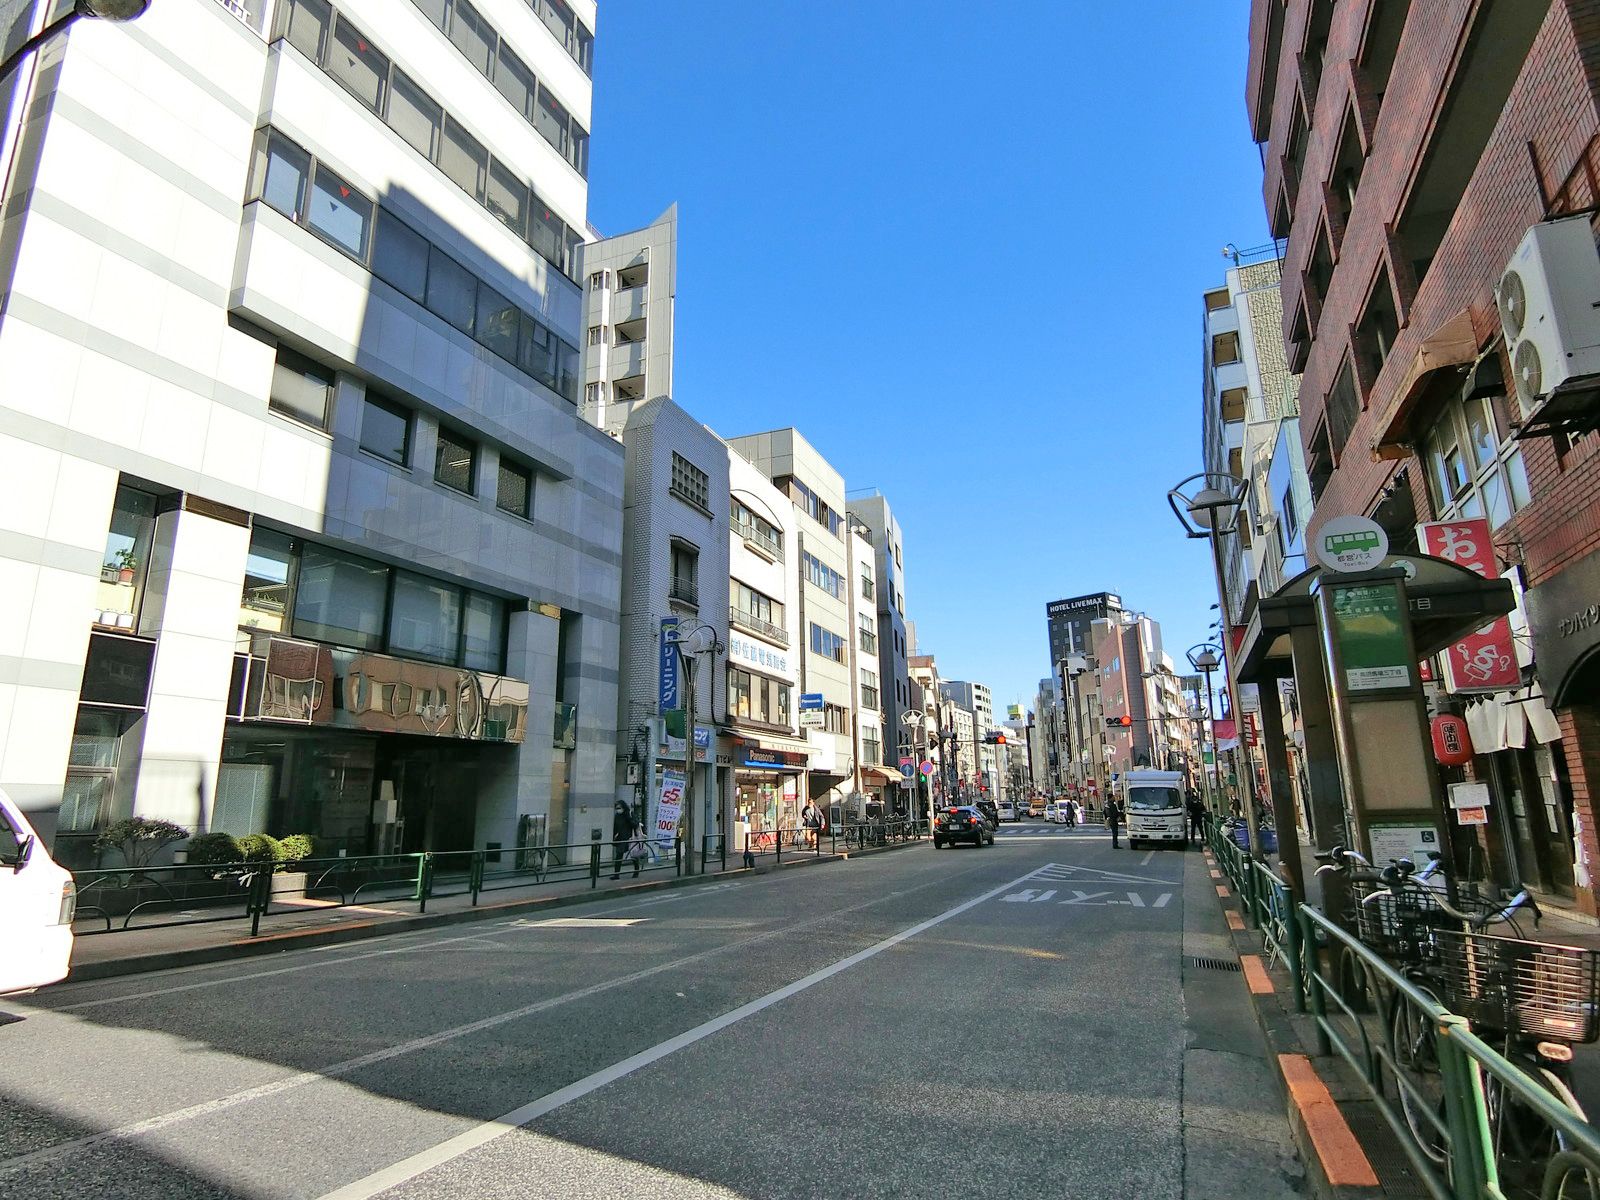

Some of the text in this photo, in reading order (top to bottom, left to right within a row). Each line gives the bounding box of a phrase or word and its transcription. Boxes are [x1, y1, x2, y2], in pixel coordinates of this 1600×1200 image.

[1337, 553, 1373, 562] 都営バス
[1049, 603, 1071, 613] HOTEL
[1071, 597, 1103, 610] LIVEMAX
[749, 749, 775, 763] Panasonic
